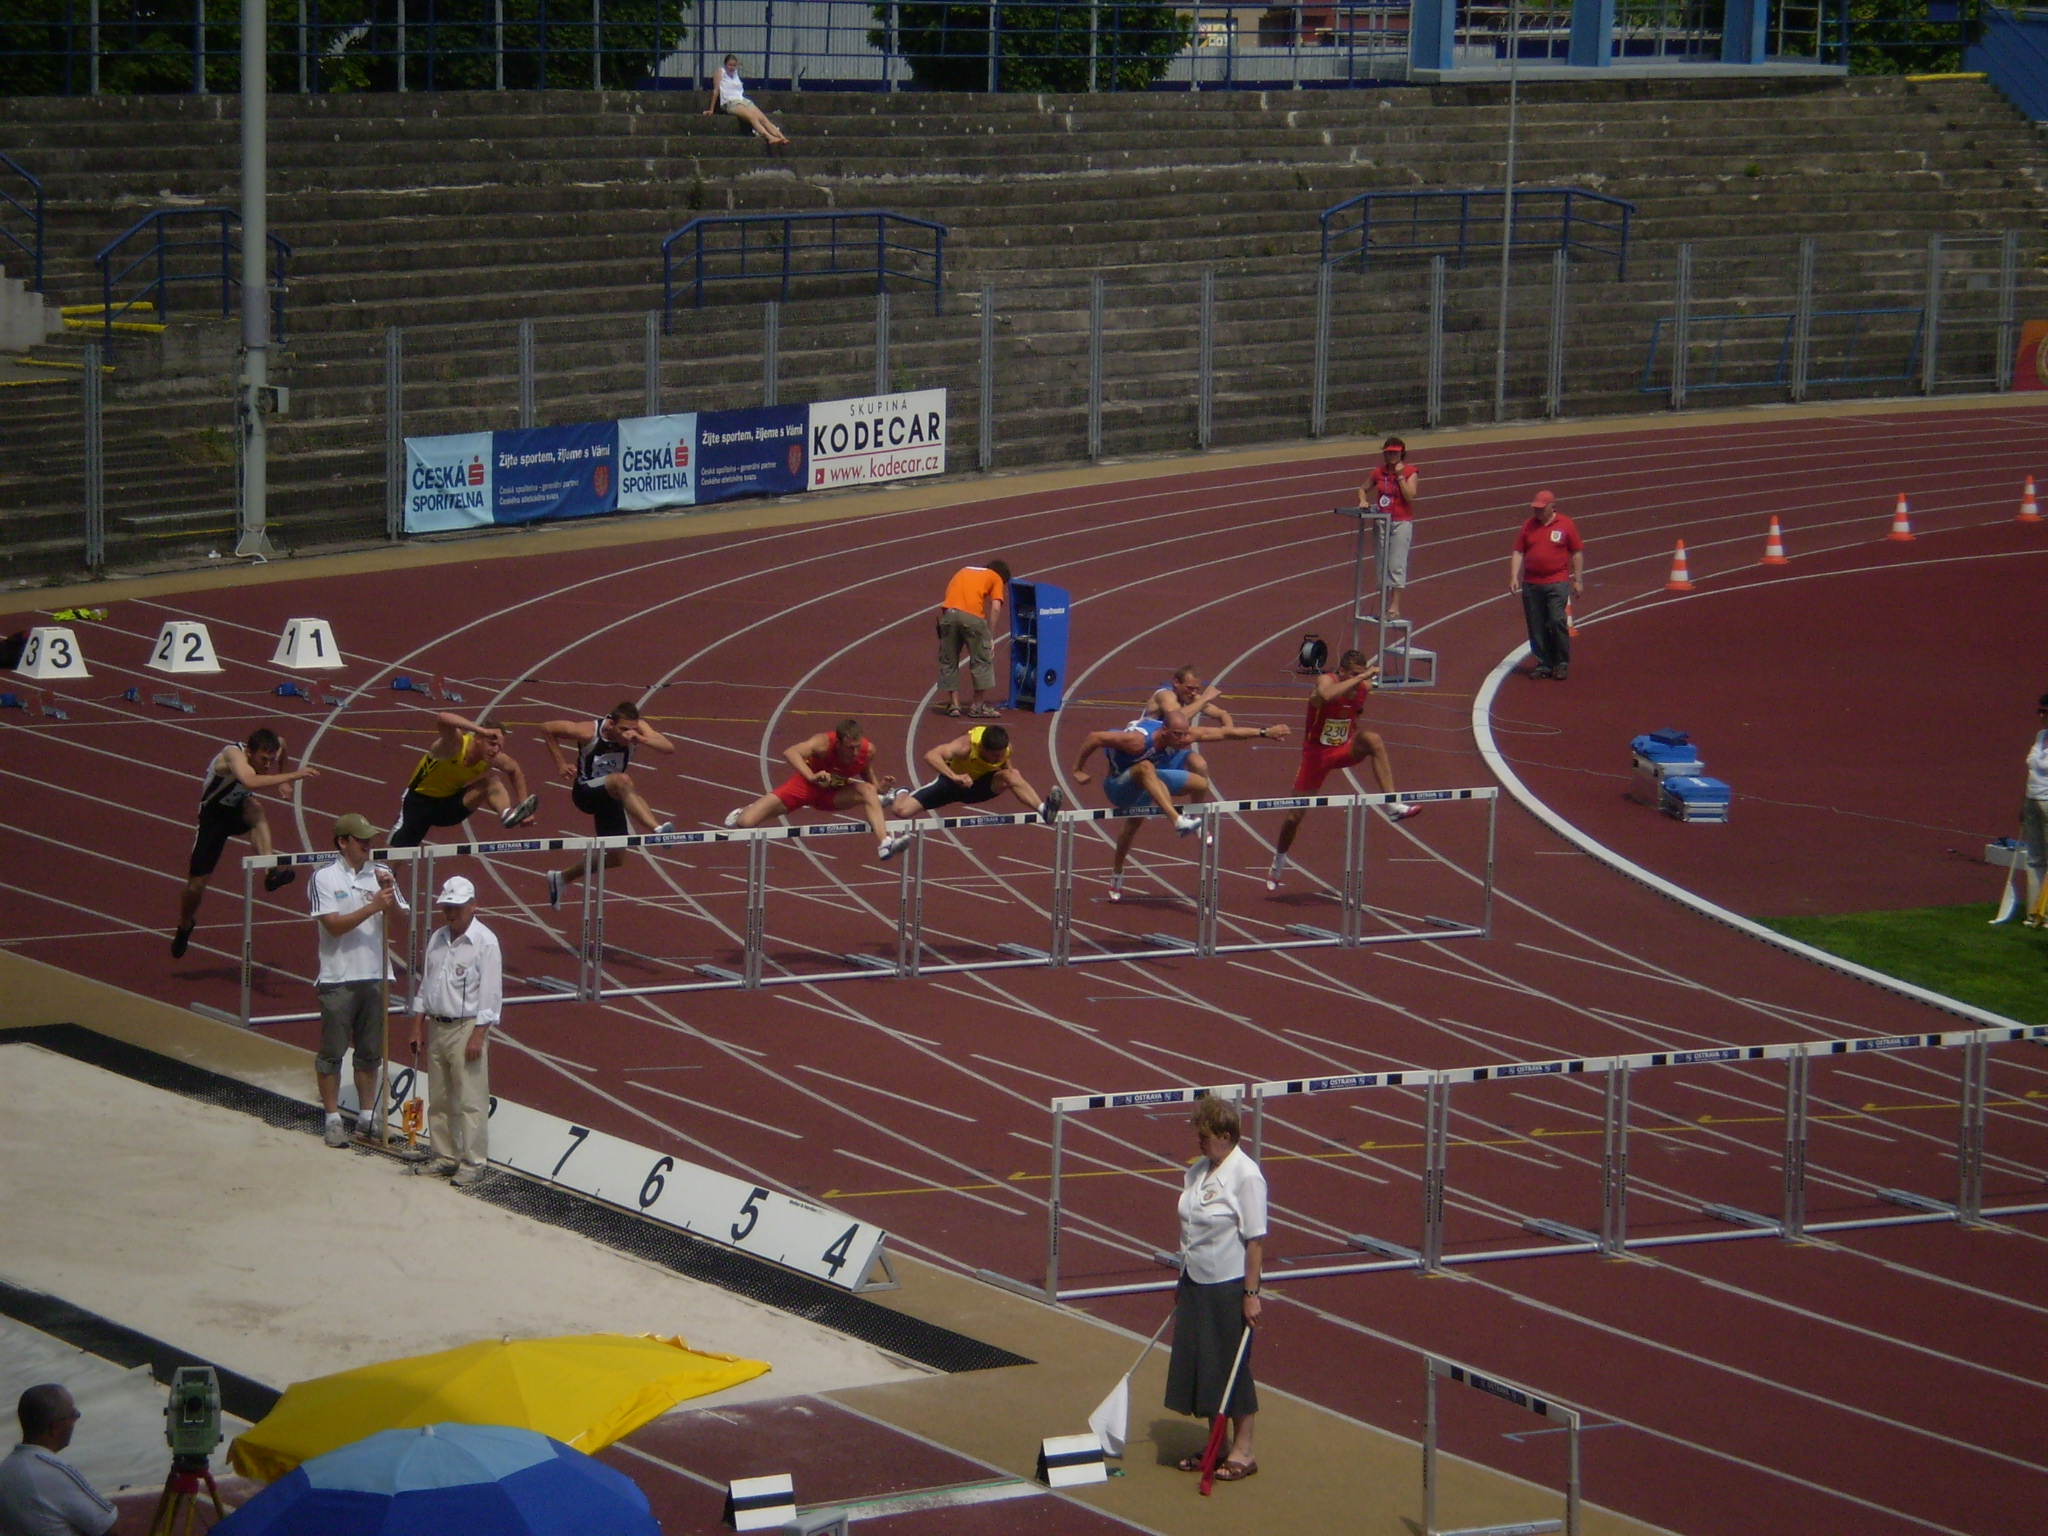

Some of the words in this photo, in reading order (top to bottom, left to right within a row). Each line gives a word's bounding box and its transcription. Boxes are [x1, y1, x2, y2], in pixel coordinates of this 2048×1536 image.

[849, 400, 908, 416] SKUPINA
[721, 430, 754, 445] sportem,
[780, 428, 785, 437] s
[813, 412, 941, 456] KODECAR
[519, 450, 556, 467] sportem,
[583, 448, 590, 458] s
[622, 441, 674, 473] ČESKÁ
[412, 459, 467, 491] ČESKÁ
[622, 472, 689, 494] SPOŘITELNA
[412, 489, 485, 513] SPOŘITELNA
[25, 636, 41, 667] 3
[49, 637, 74, 669] 3
[157, 630, 174, 661] 2
[182, 632, 205, 663] 2
[286, 626, 297, 656] 1
[308, 628, 325, 658] 1
[1324, 725, 1348, 738] 230
[1516, 1065, 1543, 1073] OSTRAVA
[1694, 1051, 1720, 1059] OSTRAVA
[1134, 1092, 1163, 1101] OSTRAVA
[1329, 1077, 1357, 1086] OSTRAVA
[551, 1126, 590, 1176] 7
[638, 1156, 674, 1208] 6
[730, 1187, 770, 1241] 5
[821, 1223, 861, 1277] 4
